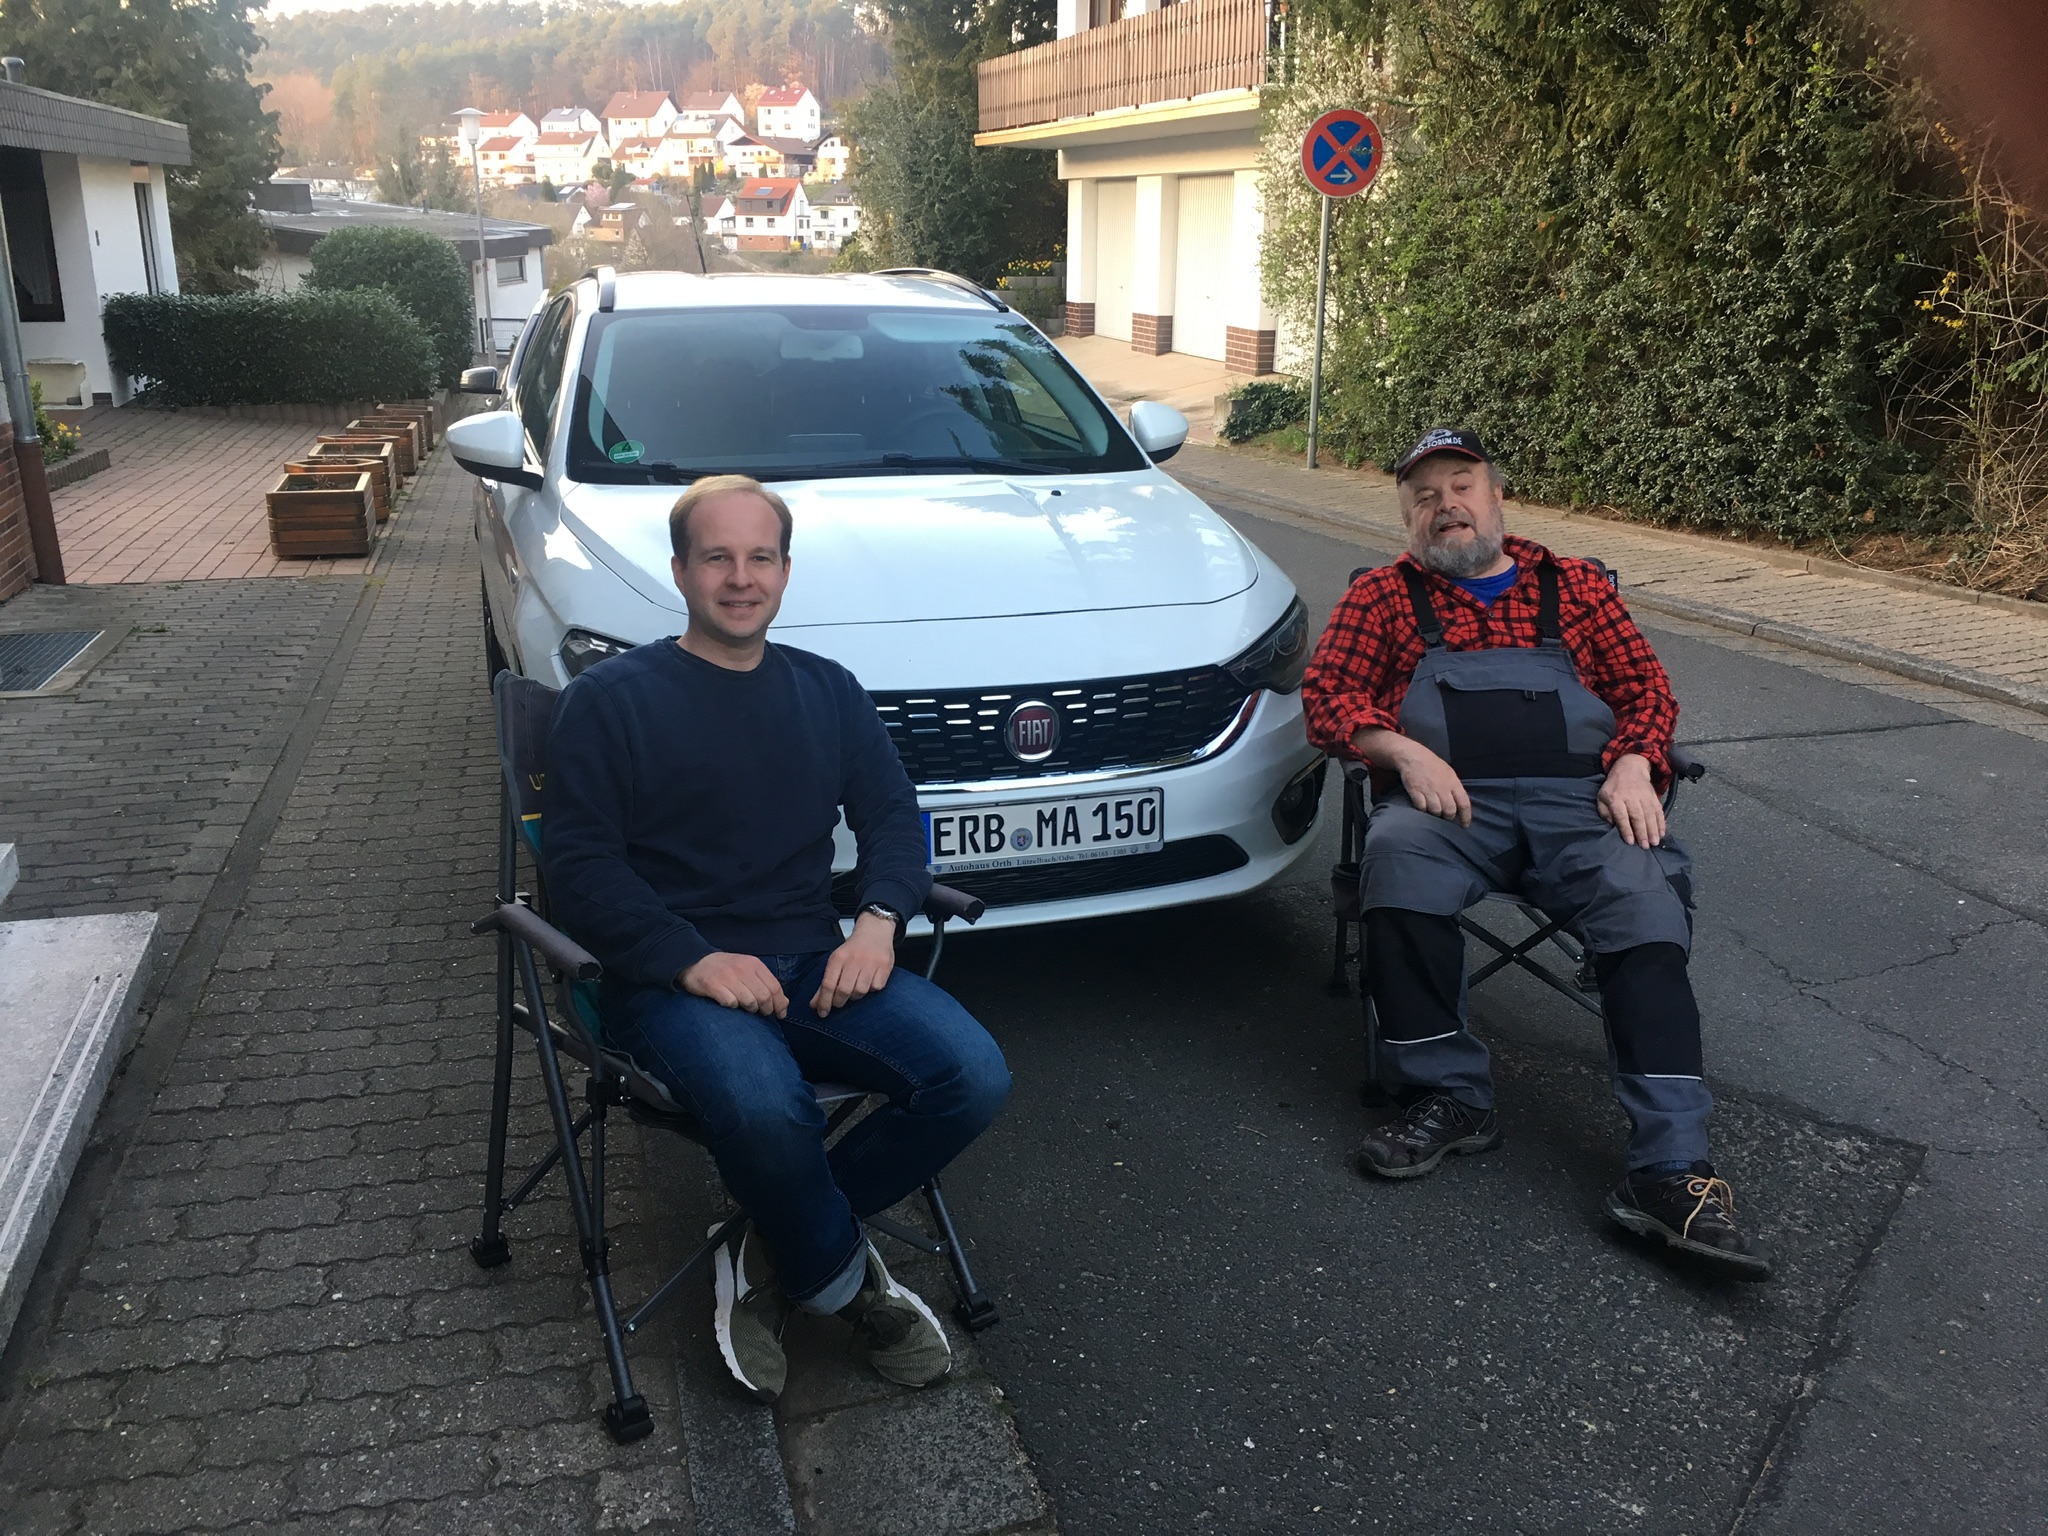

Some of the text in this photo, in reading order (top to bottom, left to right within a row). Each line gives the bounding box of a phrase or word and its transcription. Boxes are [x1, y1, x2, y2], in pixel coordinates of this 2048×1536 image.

[1018, 718, 1050, 746] FIAT
[933, 797, 1156, 857] ERB MA 150
[948, 862, 990, 872] Autohaus
[991, 859, 1012, 868] Orth
